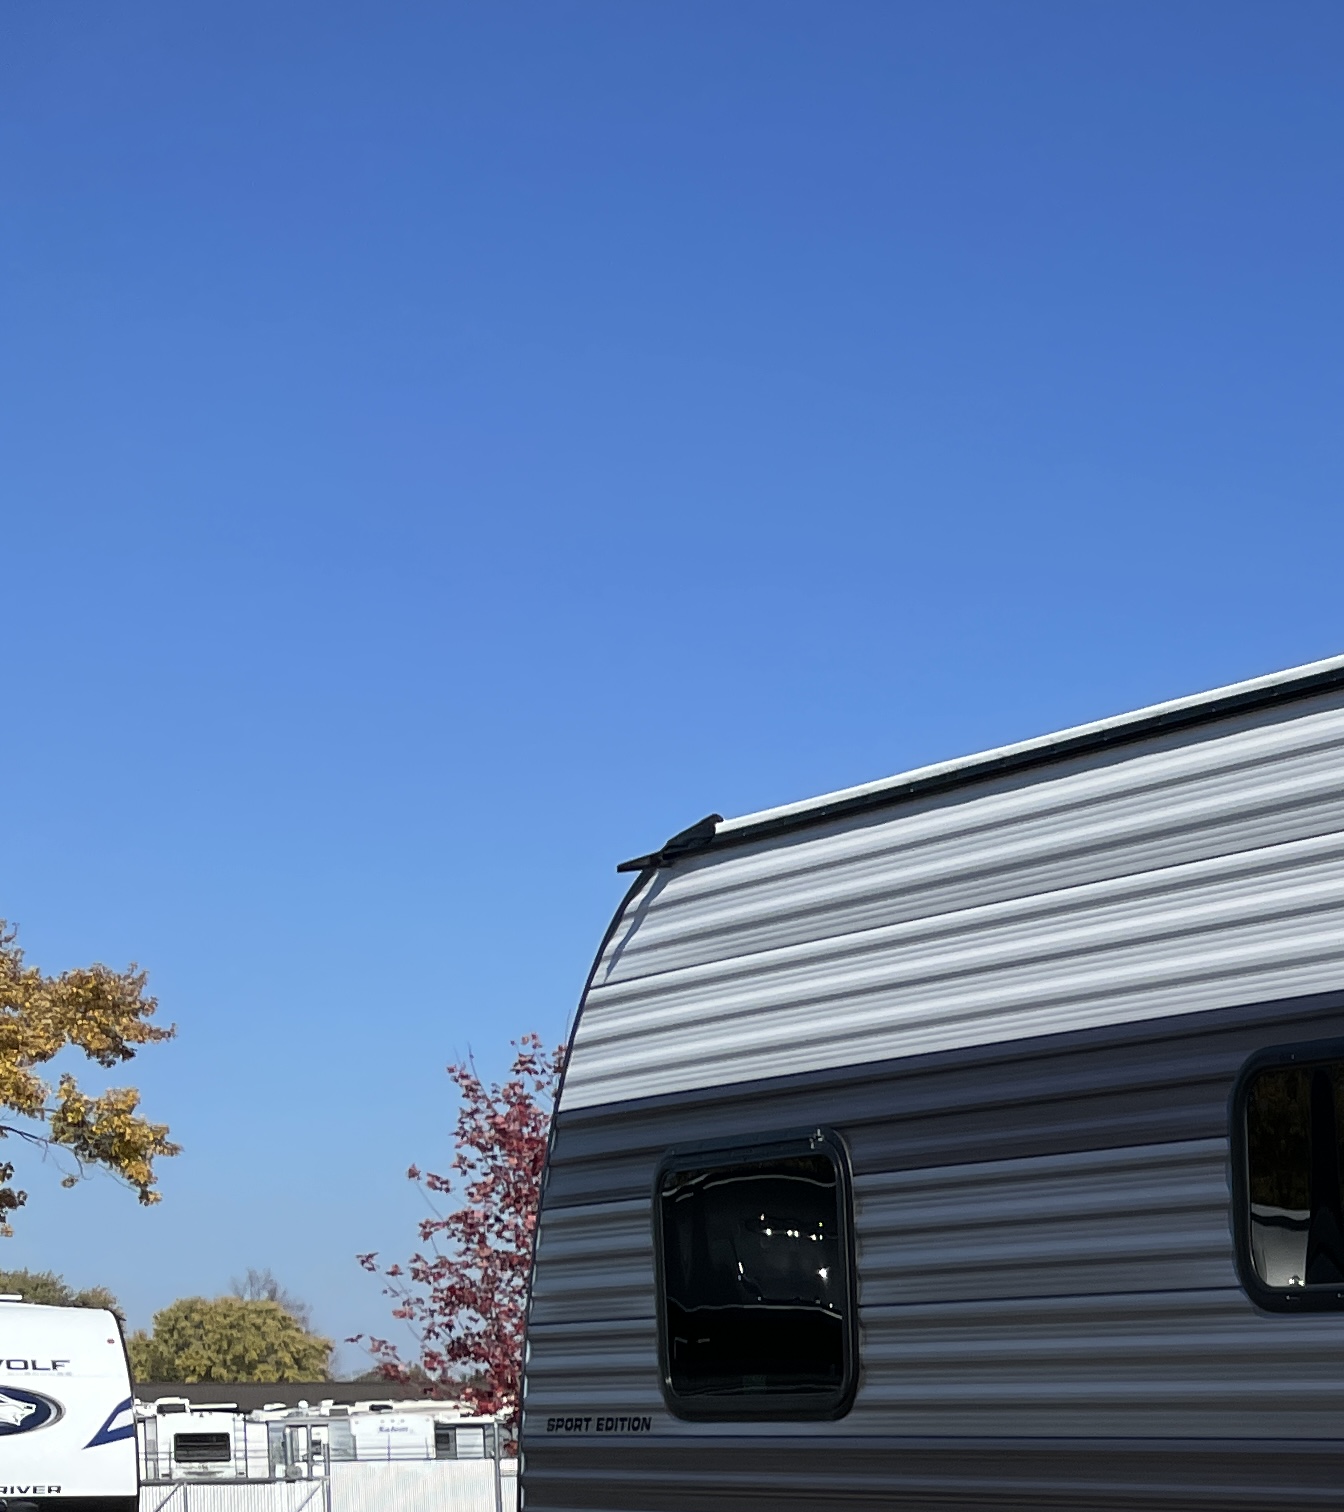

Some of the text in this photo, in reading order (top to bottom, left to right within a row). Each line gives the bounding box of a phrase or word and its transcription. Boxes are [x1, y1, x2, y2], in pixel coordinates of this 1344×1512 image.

[0, 1359, 71, 1371] OLF
[546, 1416, 653, 1433] SPORT EDITION
